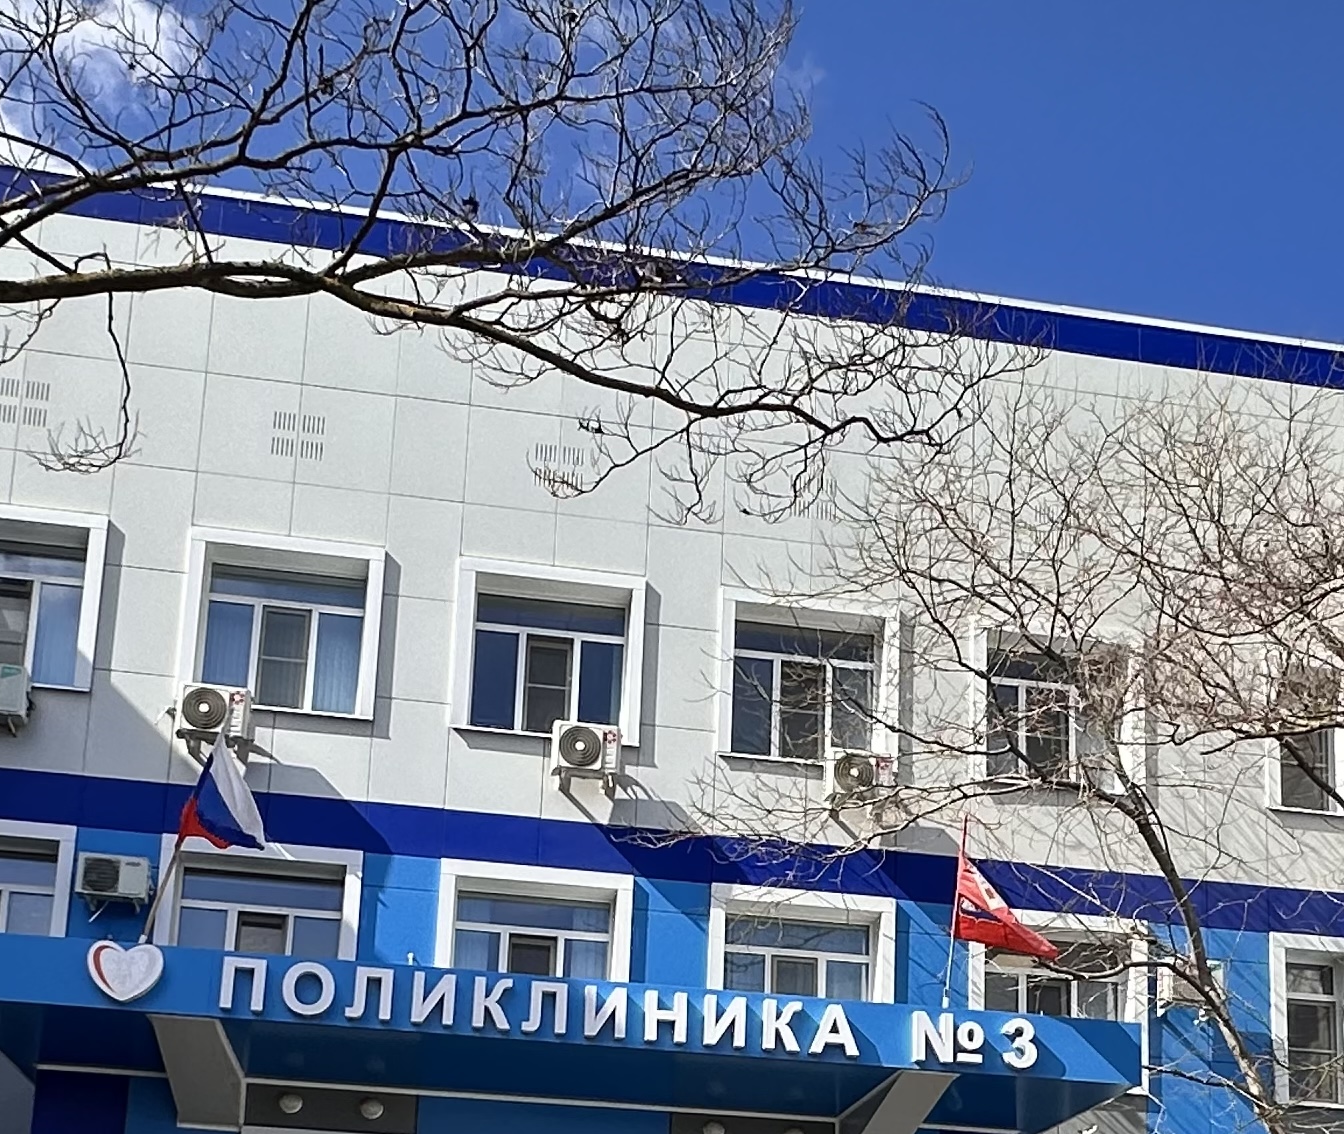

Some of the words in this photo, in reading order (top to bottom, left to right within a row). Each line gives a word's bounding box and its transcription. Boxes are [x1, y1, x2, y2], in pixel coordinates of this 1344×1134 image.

[217, 955, 860, 1058] ПОЛИКЛИНИКА
[910, 1009, 985, 1065] №
[1000, 1017, 1040, 1070] 3
